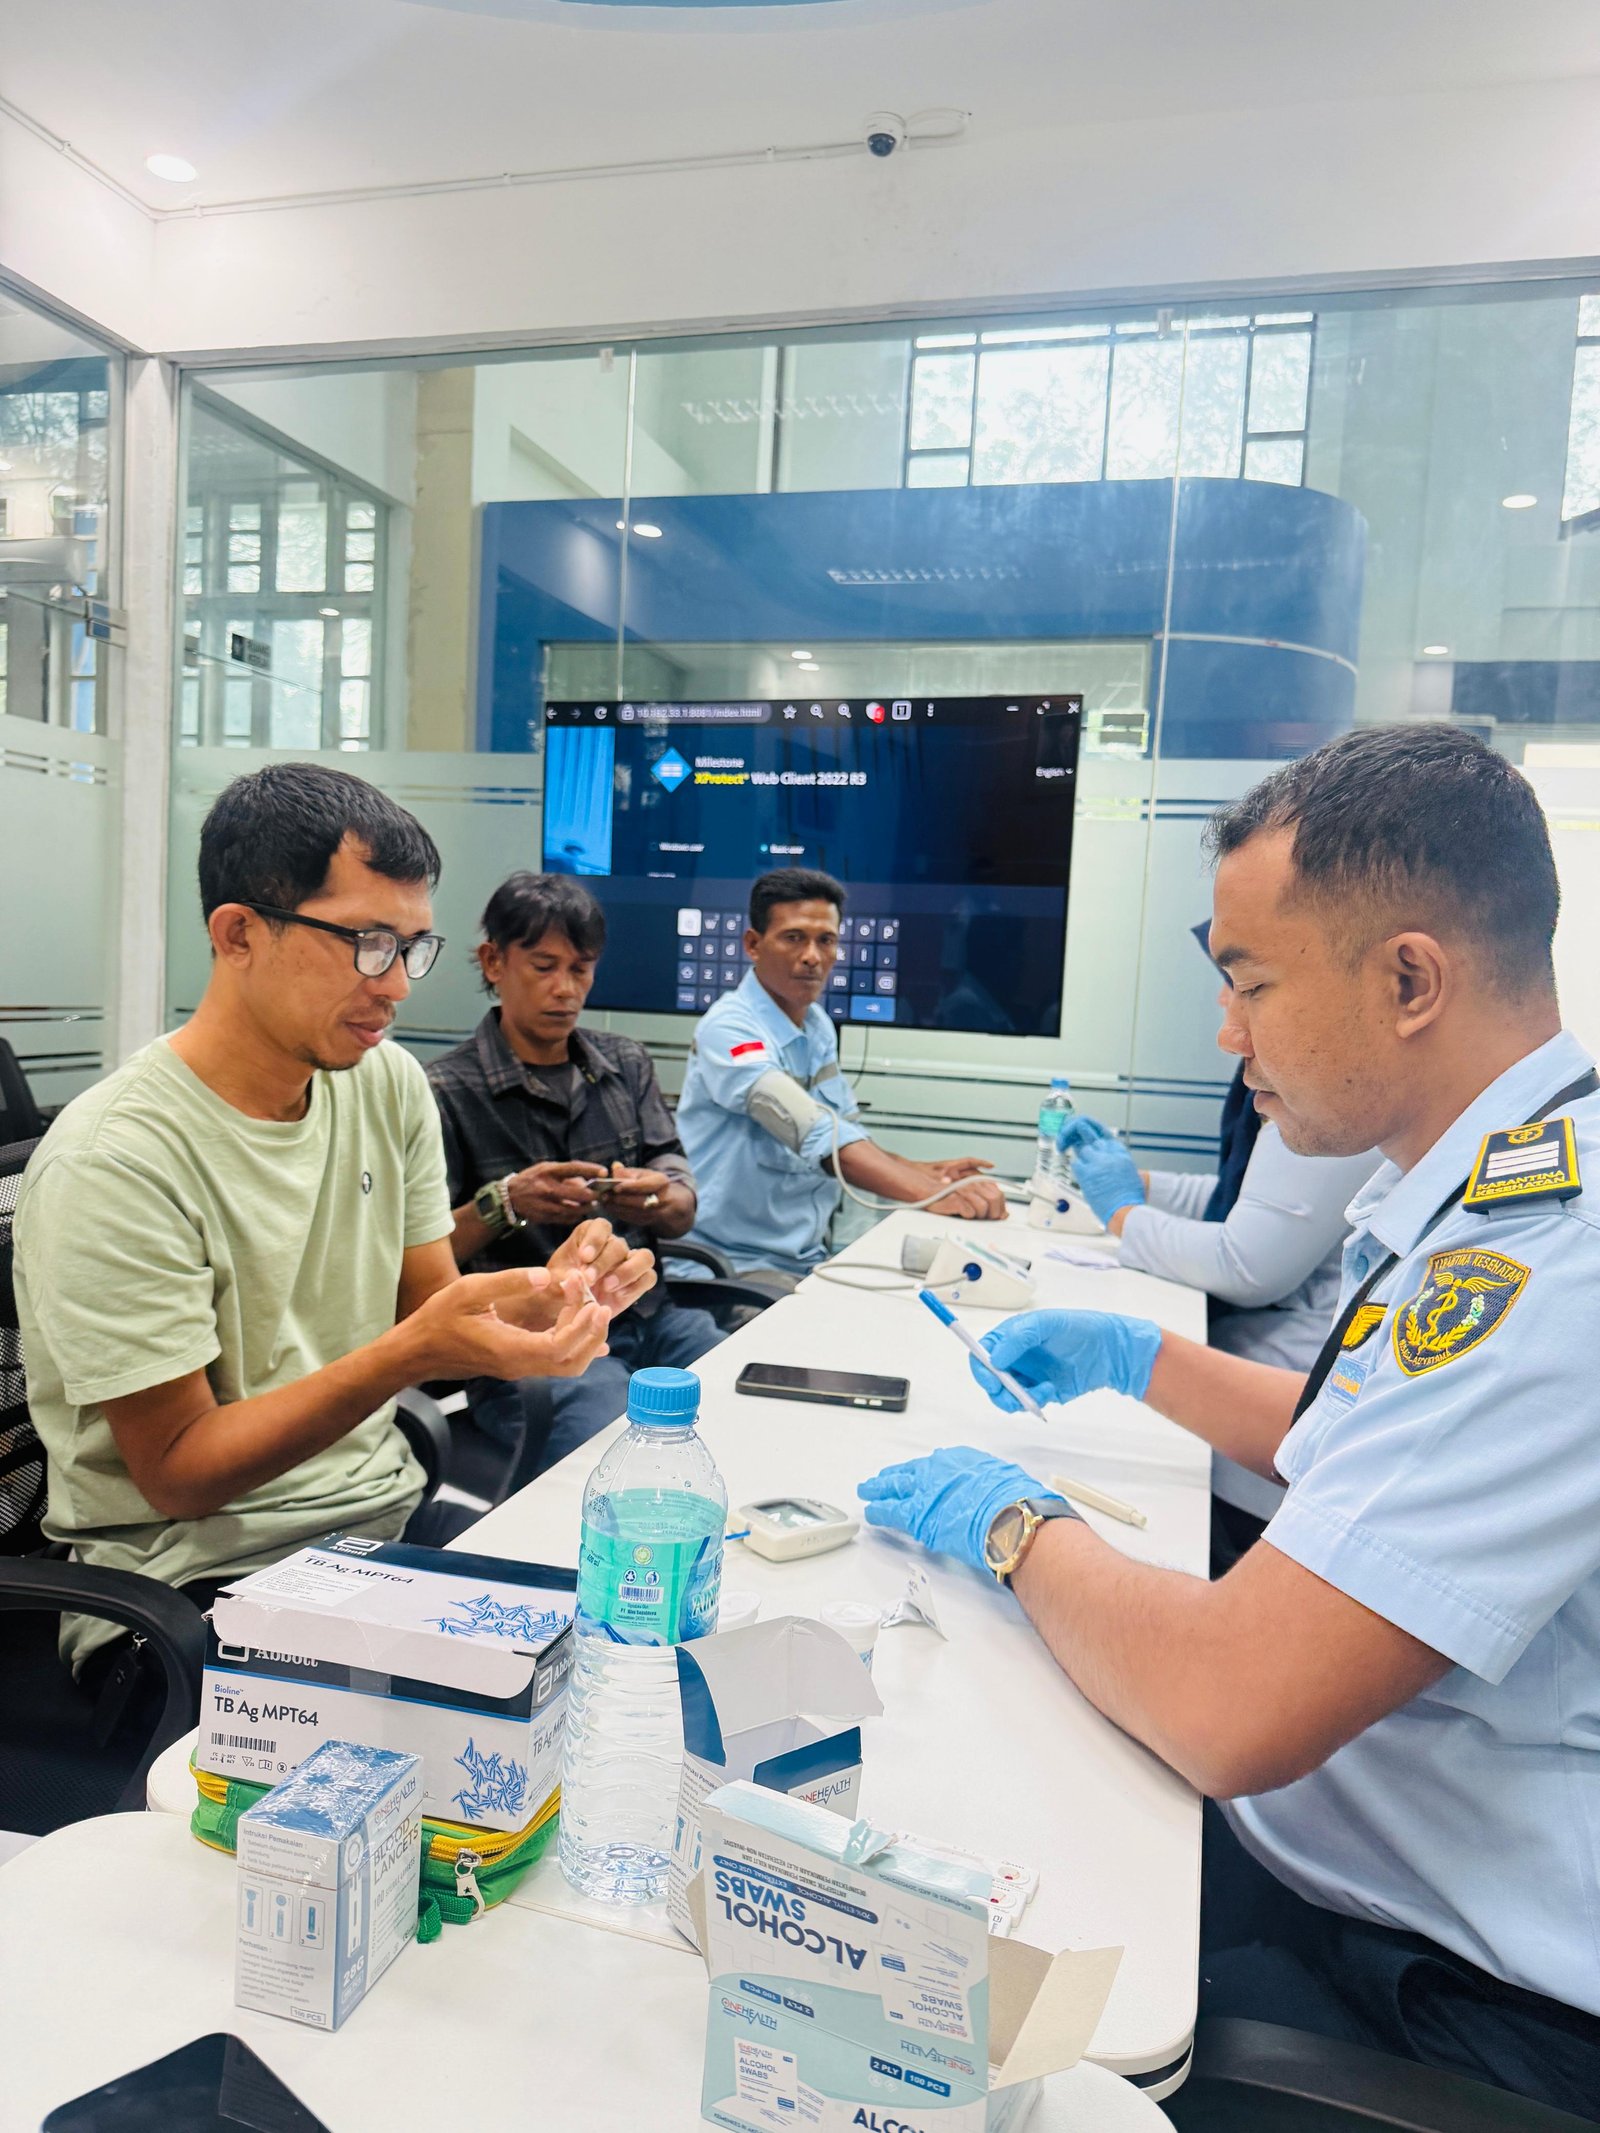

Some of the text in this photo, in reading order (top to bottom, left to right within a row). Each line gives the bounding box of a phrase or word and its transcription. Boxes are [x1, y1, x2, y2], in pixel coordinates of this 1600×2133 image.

[695, 756, 745, 768] Milestone
[750, 772, 779, 785] Web
[780, 772, 816, 785] Client
[817, 773, 849, 785] 2022
[1474, 1178, 1565, 1197] KESEHATAN
[1476, 1170, 1565, 1190] KARANTINA
[1472, 1253, 1524, 1283] KESEHATAN
[304, 1557, 415, 1584] TB Ag MPT64
[214, 1696, 319, 1726] TB Ag MPT64
[244, 1828, 267, 1839] Intruksi
[269, 1834, 303, 1848] Pemakaian
[373, 1816, 410, 1866] BLOOD
[373, 1822, 419, 1886] LANCETS
[719, 1859, 738, 1869] ONLY
[739, 1864, 754, 1874] USE
[754, 1870, 788, 1888] EXTERNAL
[715, 1871, 806, 1921] SWABS
[797, 1885, 831, 1905] ALCOHOL
[833, 1900, 855, 1913] ETHYL
[716, 1894, 868, 1971] ALCOHOL
[786, 2000, 804, 2011] PLY
[908, 2000, 964, 2021] ALCOHOL
[921, 1993, 963, 2011] SWABS
[306, 2013, 322, 2021] PCS
[721, 1997, 778, 2031] ONEHEALTH
[739, 2057, 778, 2074] ALCOHOL
[900, 2040, 975, 2076] ONEHEALTH
[739, 2065, 769, 2080] SWABS
[873, 2061, 899, 2076] 2 PLY
[909, 2075, 946, 2094] 100 PCS
[852, 2107, 924, 2133] ALC
